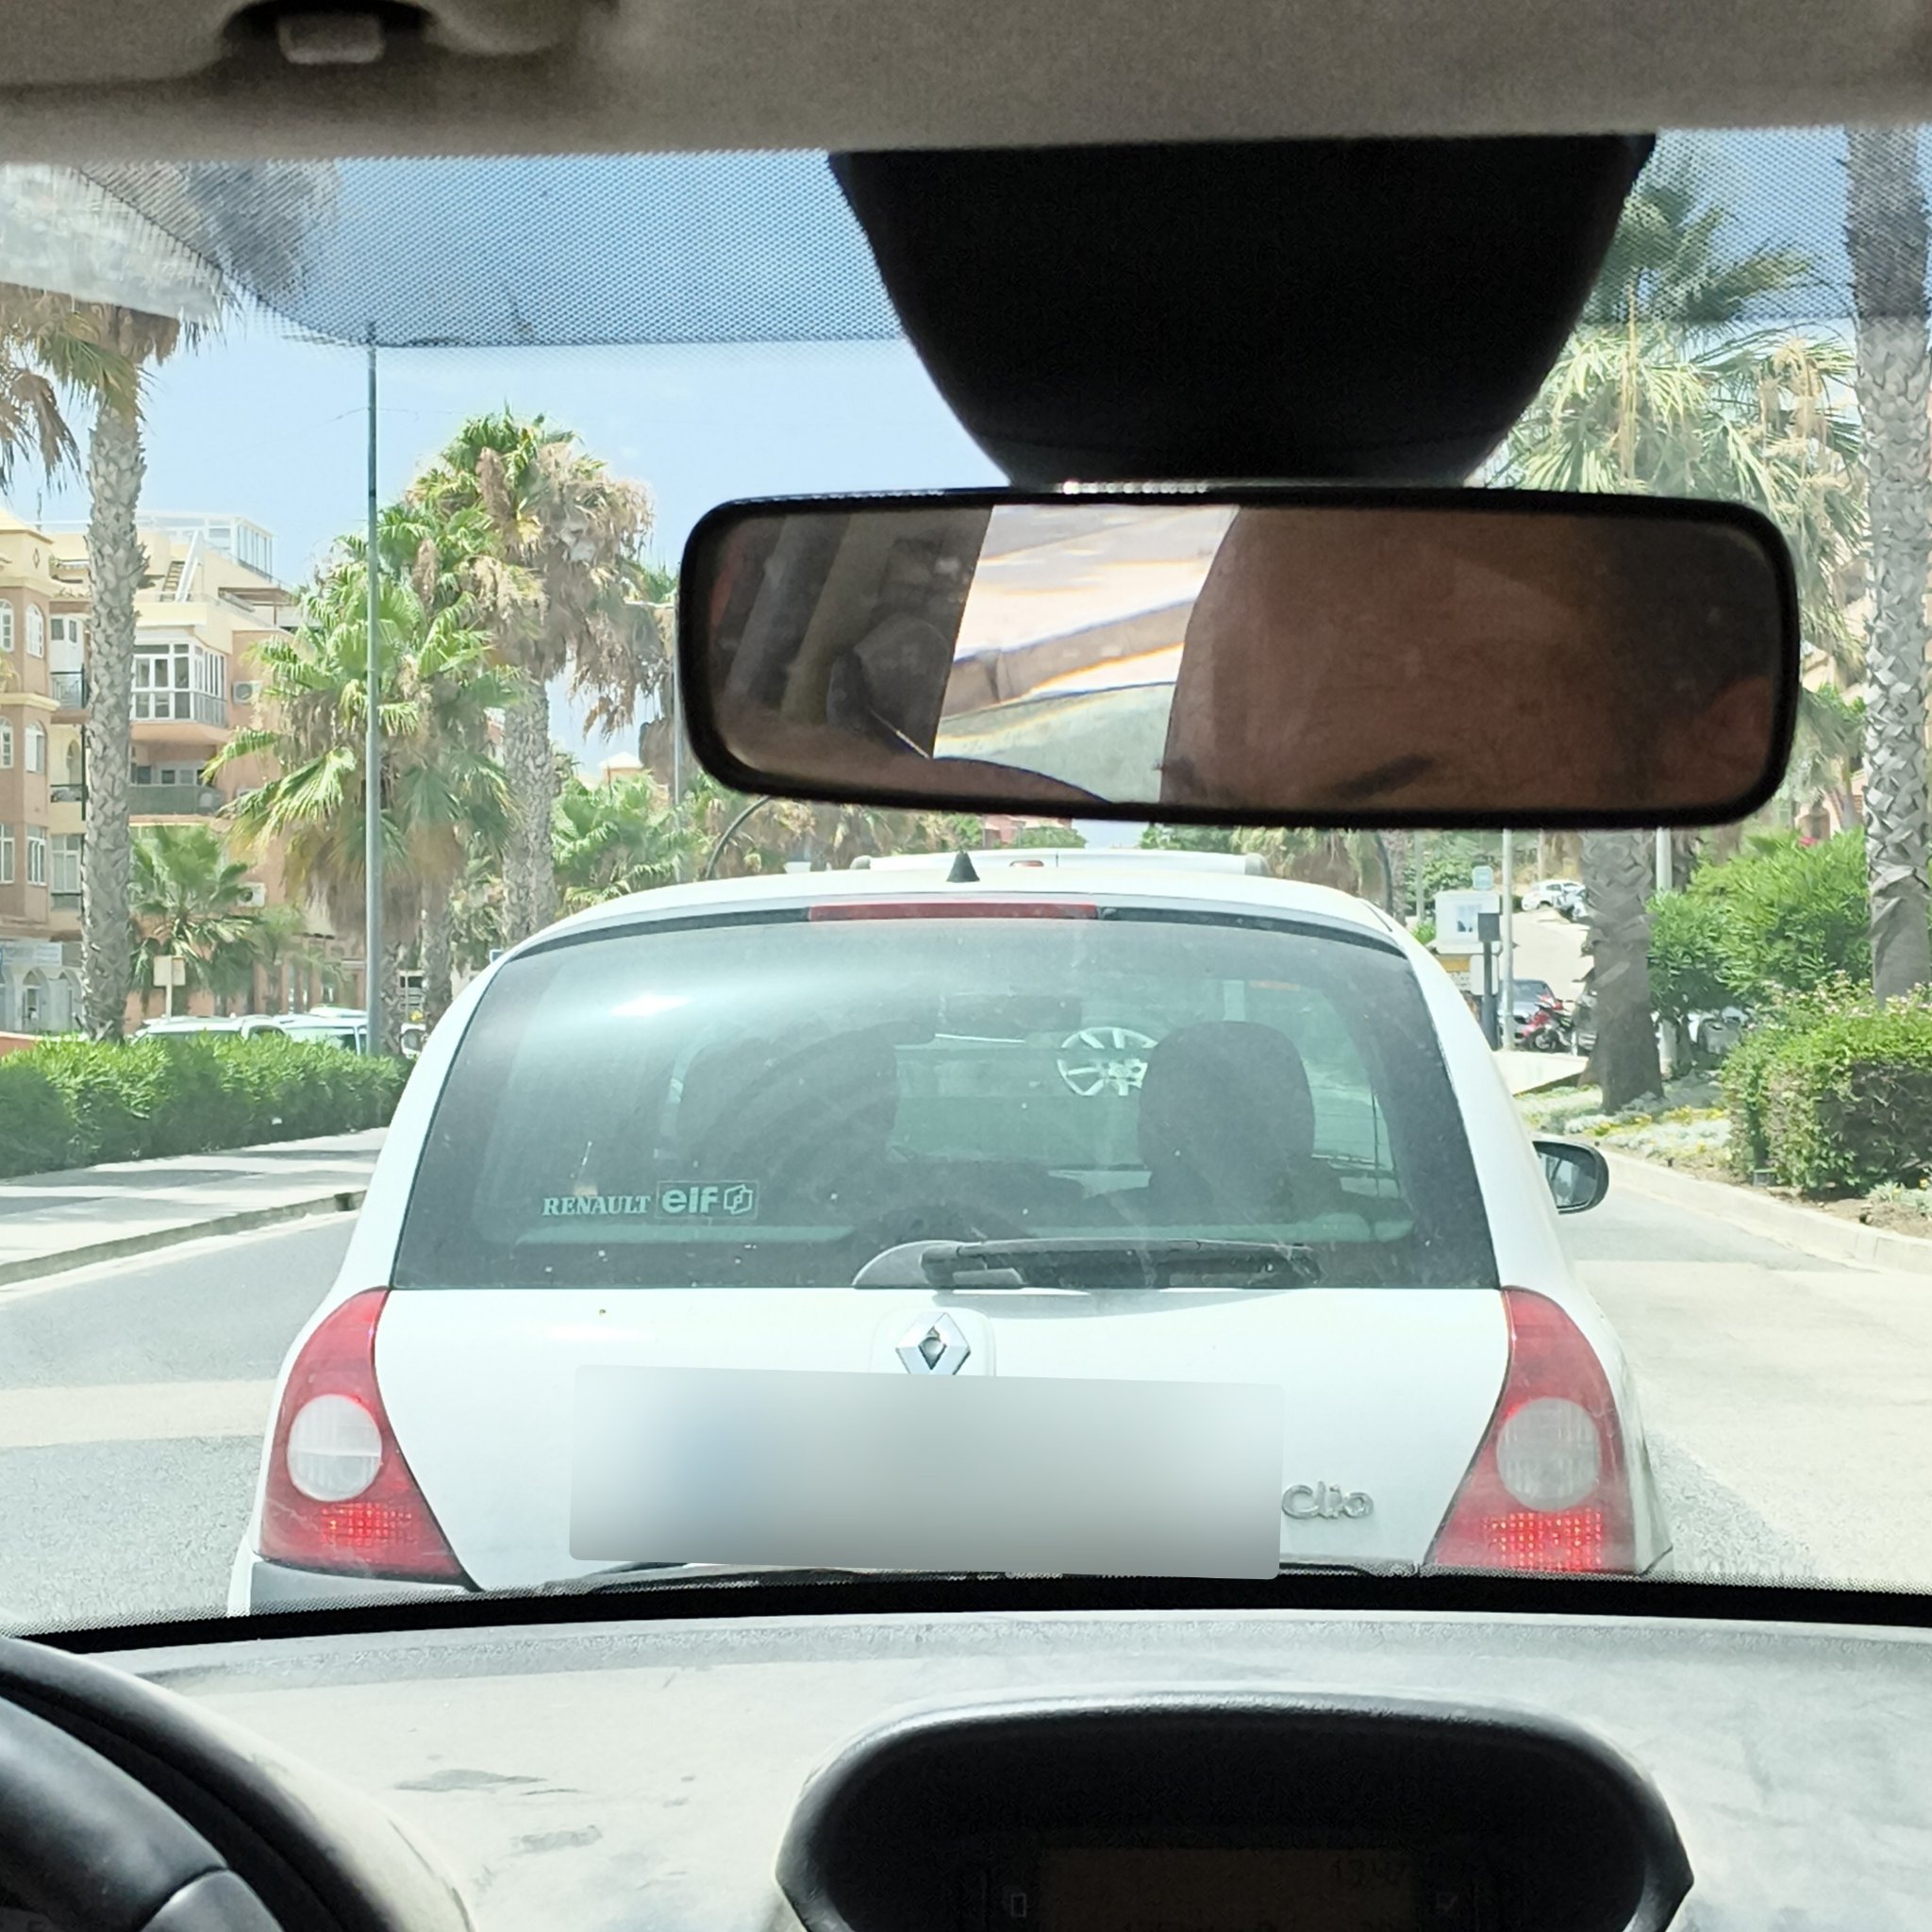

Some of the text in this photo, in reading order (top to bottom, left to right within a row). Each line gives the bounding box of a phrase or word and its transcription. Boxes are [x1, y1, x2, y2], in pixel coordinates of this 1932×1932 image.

[541, 1186, 719, 1216] RENAULT elf
[1281, 1480, 1374, 1520] Clio
